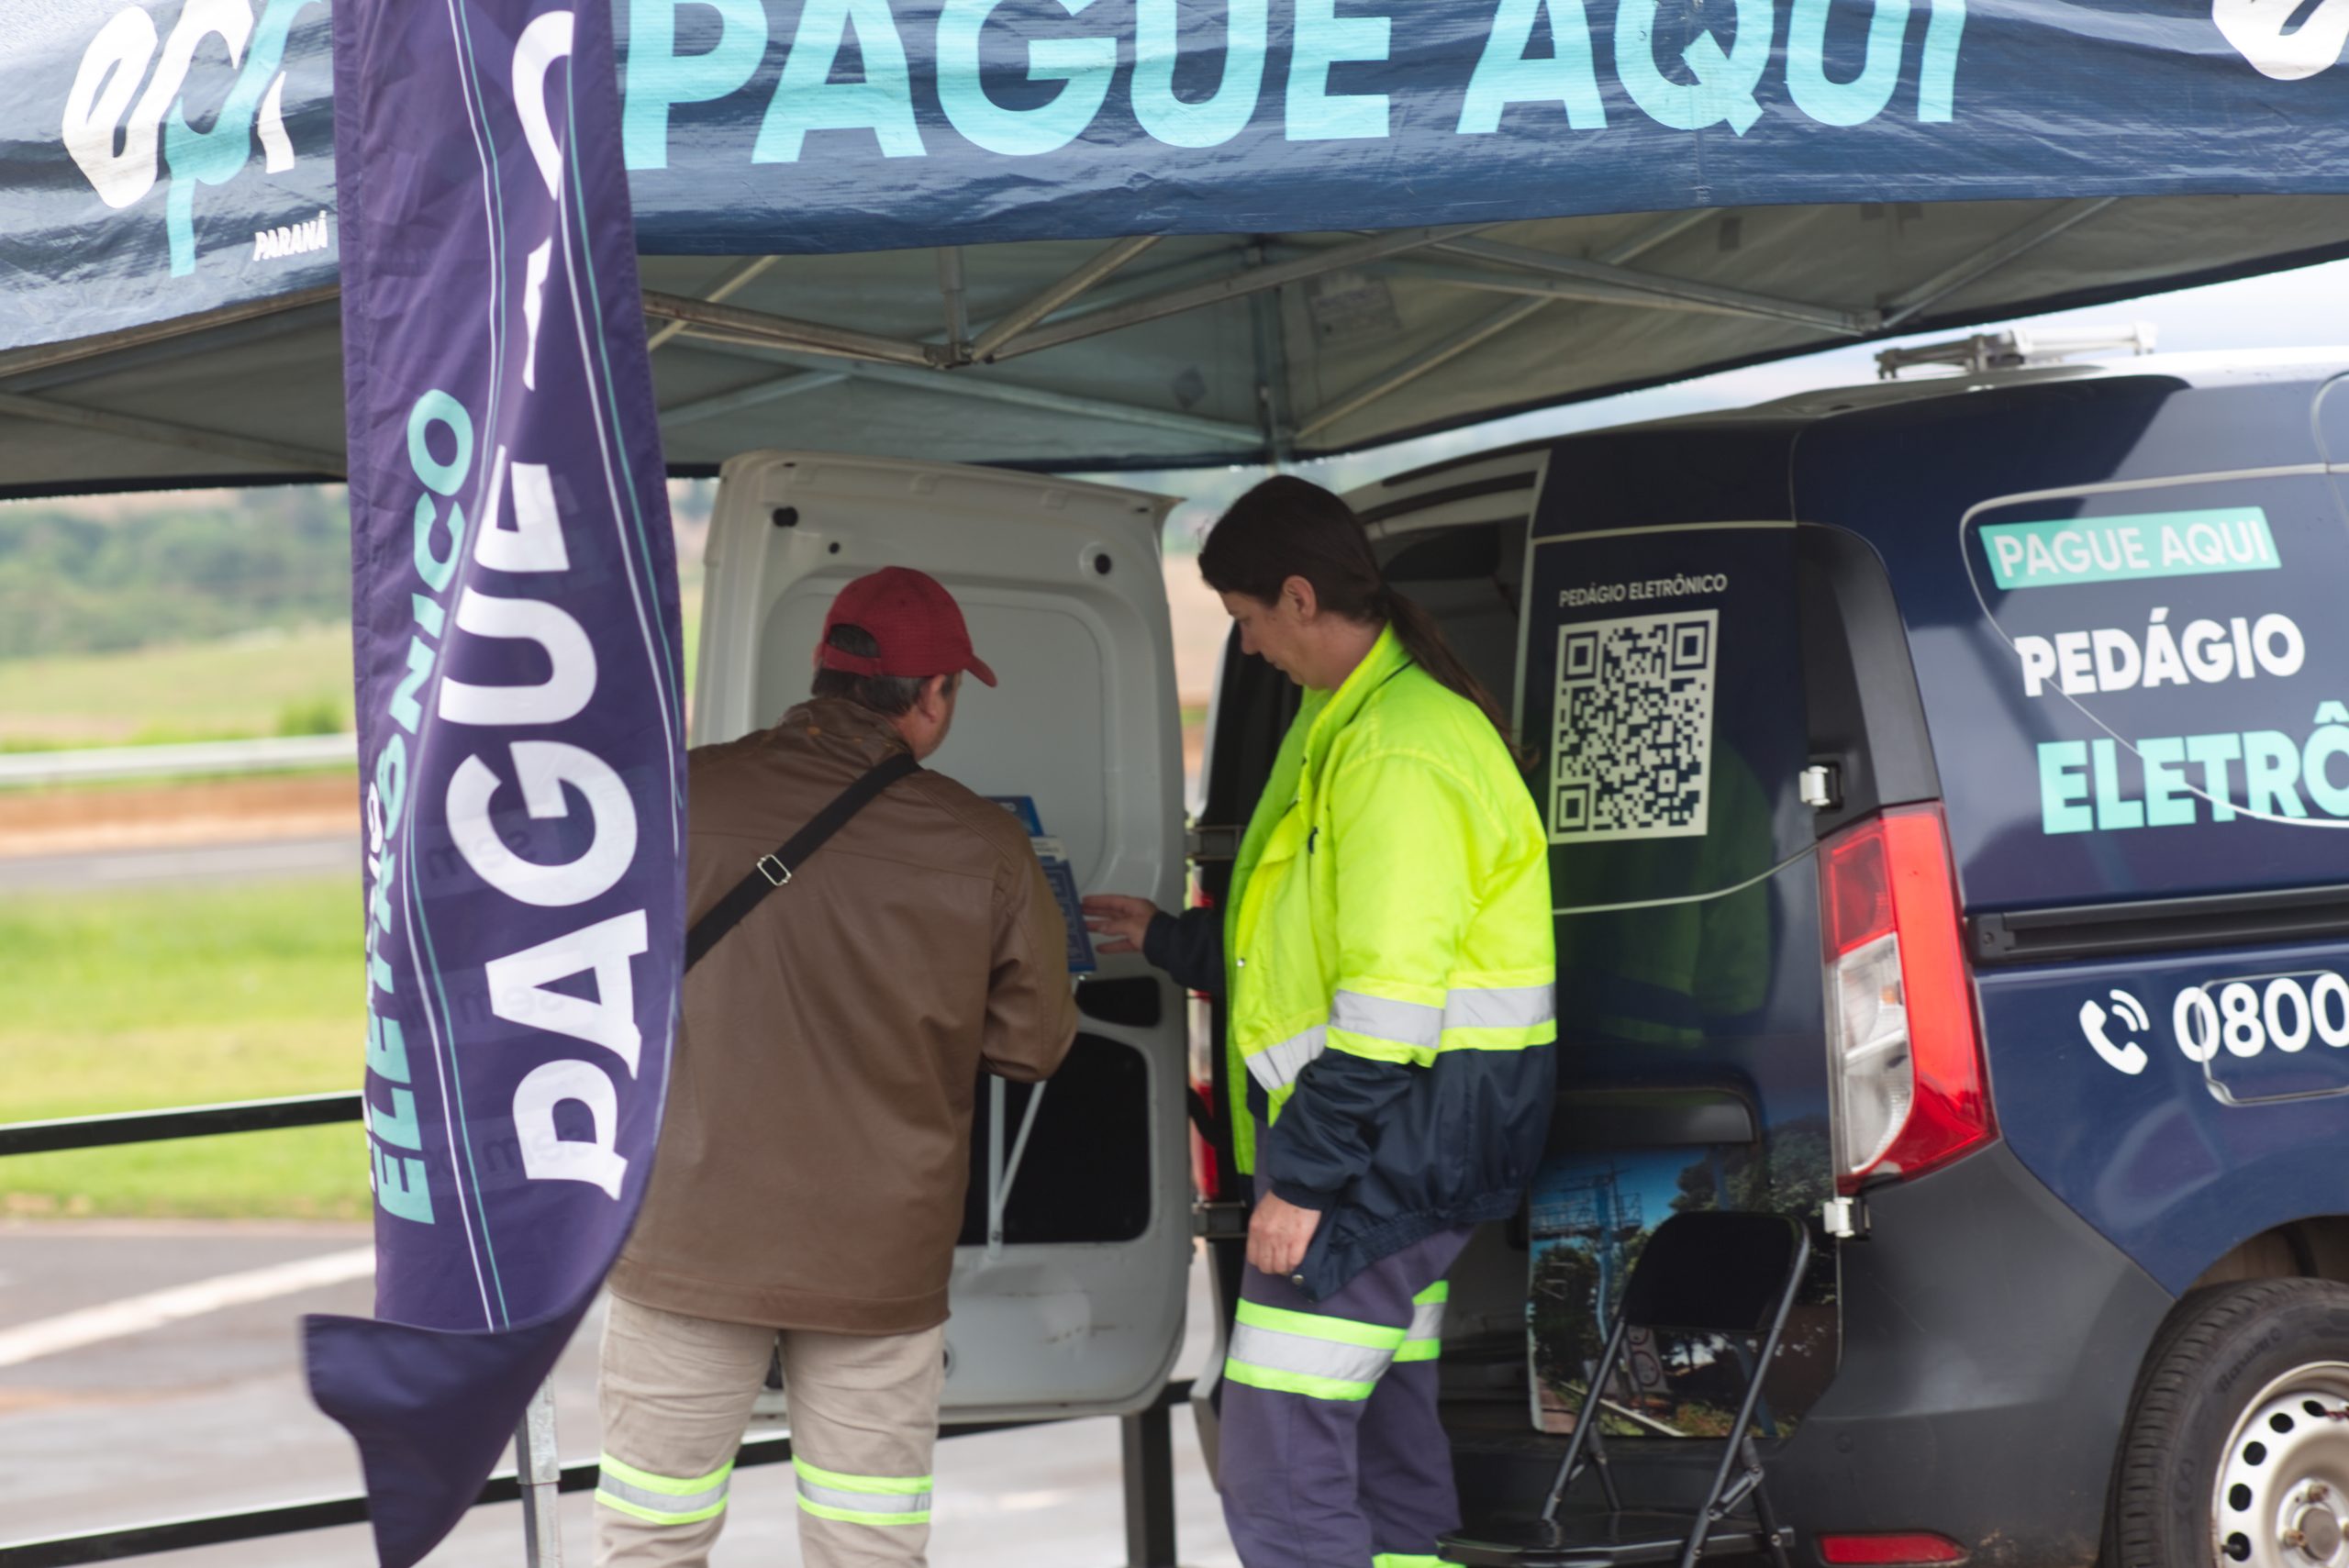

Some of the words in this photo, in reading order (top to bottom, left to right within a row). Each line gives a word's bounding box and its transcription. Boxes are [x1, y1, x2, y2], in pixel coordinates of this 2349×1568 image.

[621, 0, 1392, 170] PAGUE
[1455, 0, 1968, 138] AQUI
[253, 210, 328, 261] PARANÁ
[1559, 582, 1626, 607] PEDÁGIO
[1629, 573, 1728, 601] ELETRÔNICO
[1993, 527, 2150, 578] PAGUE
[2161, 519, 2269, 567] AQUI
[2013, 606, 2306, 697] PEDÁGIO
[2037, 700, 2349, 835] ELETRÔ
[2172, 973, 2349, 1062] 0800
